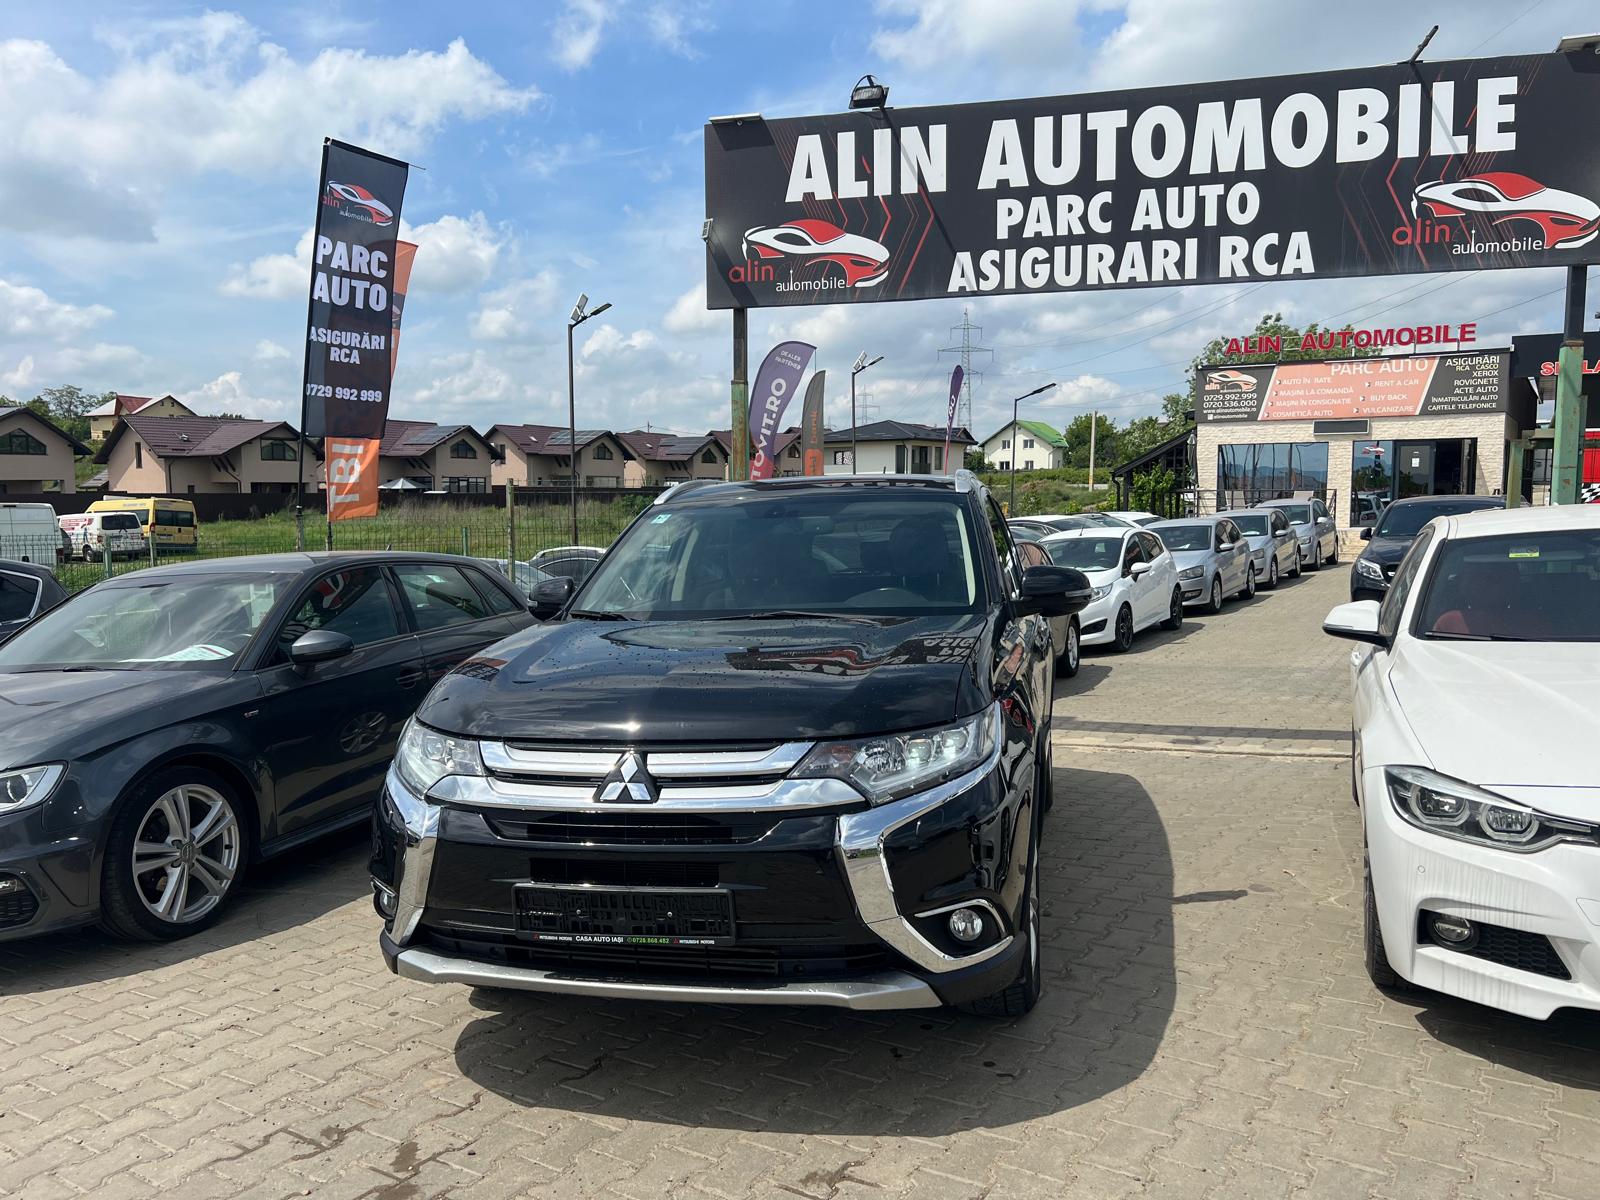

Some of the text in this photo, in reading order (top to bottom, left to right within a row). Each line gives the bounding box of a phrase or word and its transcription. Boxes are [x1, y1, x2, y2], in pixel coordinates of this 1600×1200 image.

[785, 76, 1518, 203] ALIN AUTOMOBILE
[996, 181, 1259, 239] PARC AUTO
[1392, 218, 1450, 245] alin
[316, 235, 388, 278] PARC
[947, 231, 1315, 293] ASIGURARI RCA
[728, 259, 774, 283] alin
[312, 271, 387, 311] AUTO
[309, 326, 385, 350] ASIGURĂRI
[1225, 323, 1477, 355] ALIN AUTOMOBILE
[330, 347, 360, 365] RCA
[1331, 358, 1429, 376] PARC AUTO
[1445, 355, 1500, 366] ASIGURĂRI
[305, 384, 383, 403] 0729 992 999
[1454, 378, 1499, 386] ROVIGNETE
[1203, 393, 1258, 401] 0729.992.999
[1203, 400, 1257, 408] 0720.536.000
[1362, 405, 1415, 413] VULCANIZARE
[1457, 402, 1497, 410] TELEFONICE
[329, 443, 364, 513] TBI
